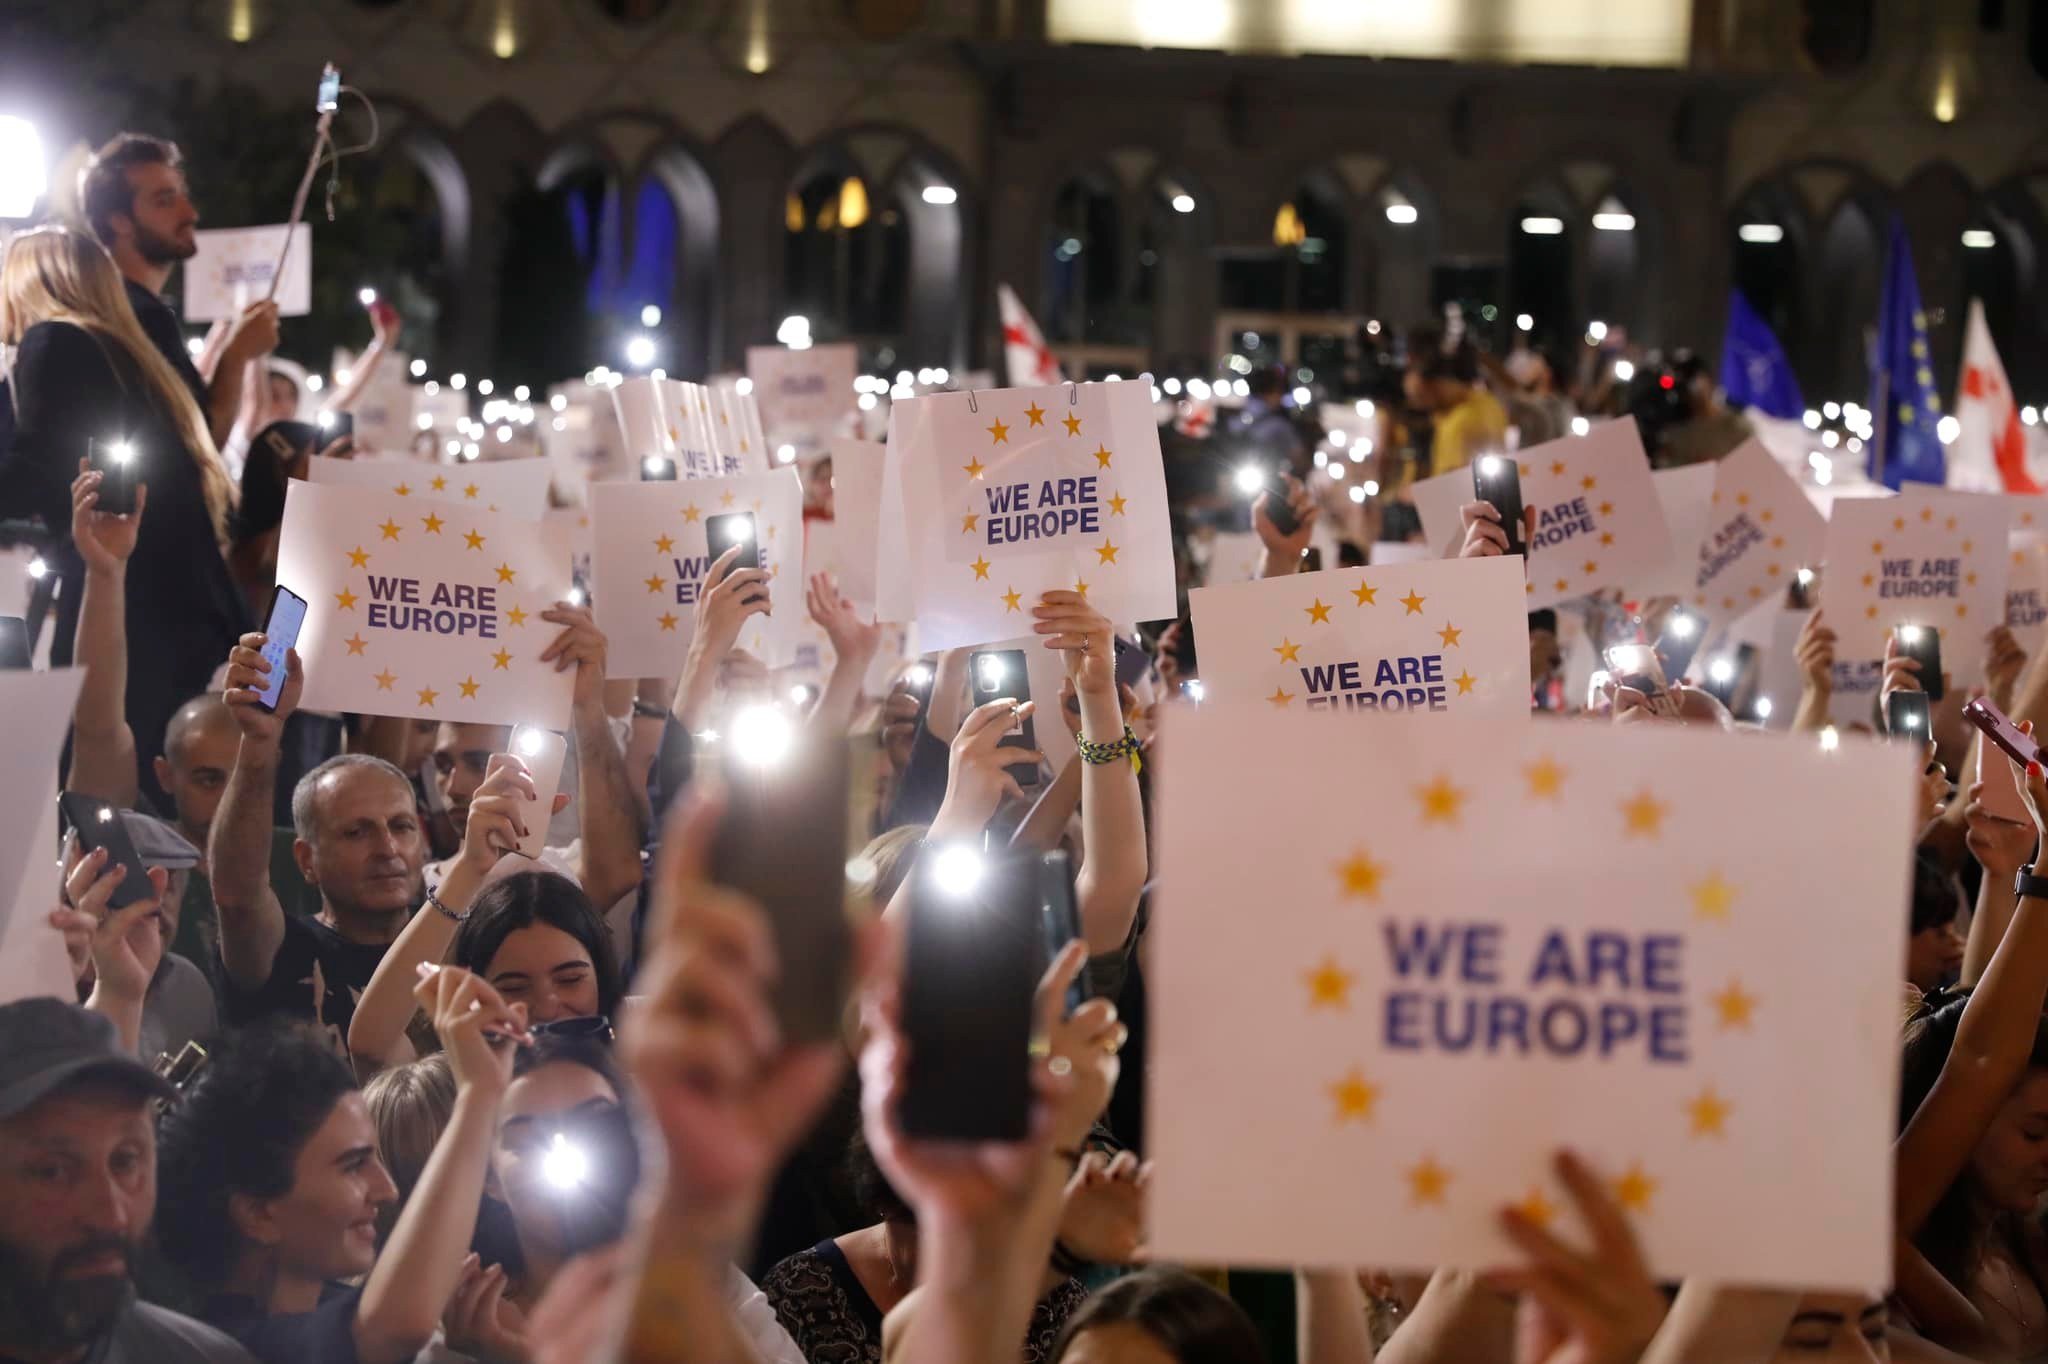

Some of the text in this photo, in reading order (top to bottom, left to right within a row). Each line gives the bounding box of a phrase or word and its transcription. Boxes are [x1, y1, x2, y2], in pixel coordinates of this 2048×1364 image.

[985, 476, 1097, 514] WE ARE
[1540, 496, 1588, 528] ARE
[987, 507, 1099, 545] EUROPE
[1532, 514, 1596, 551] ROPE
[1881, 557, 1960, 577] WE ARE
[367, 575, 497, 612] WE ARE
[1879, 579, 1959, 599] EUROPE
[367, 603, 498, 639] EUROPE
[1300, 655, 1444, 694] WE ARE
[1380, 919, 1684, 995] WE ARE
[1383, 992, 1689, 1064] EUROPE
